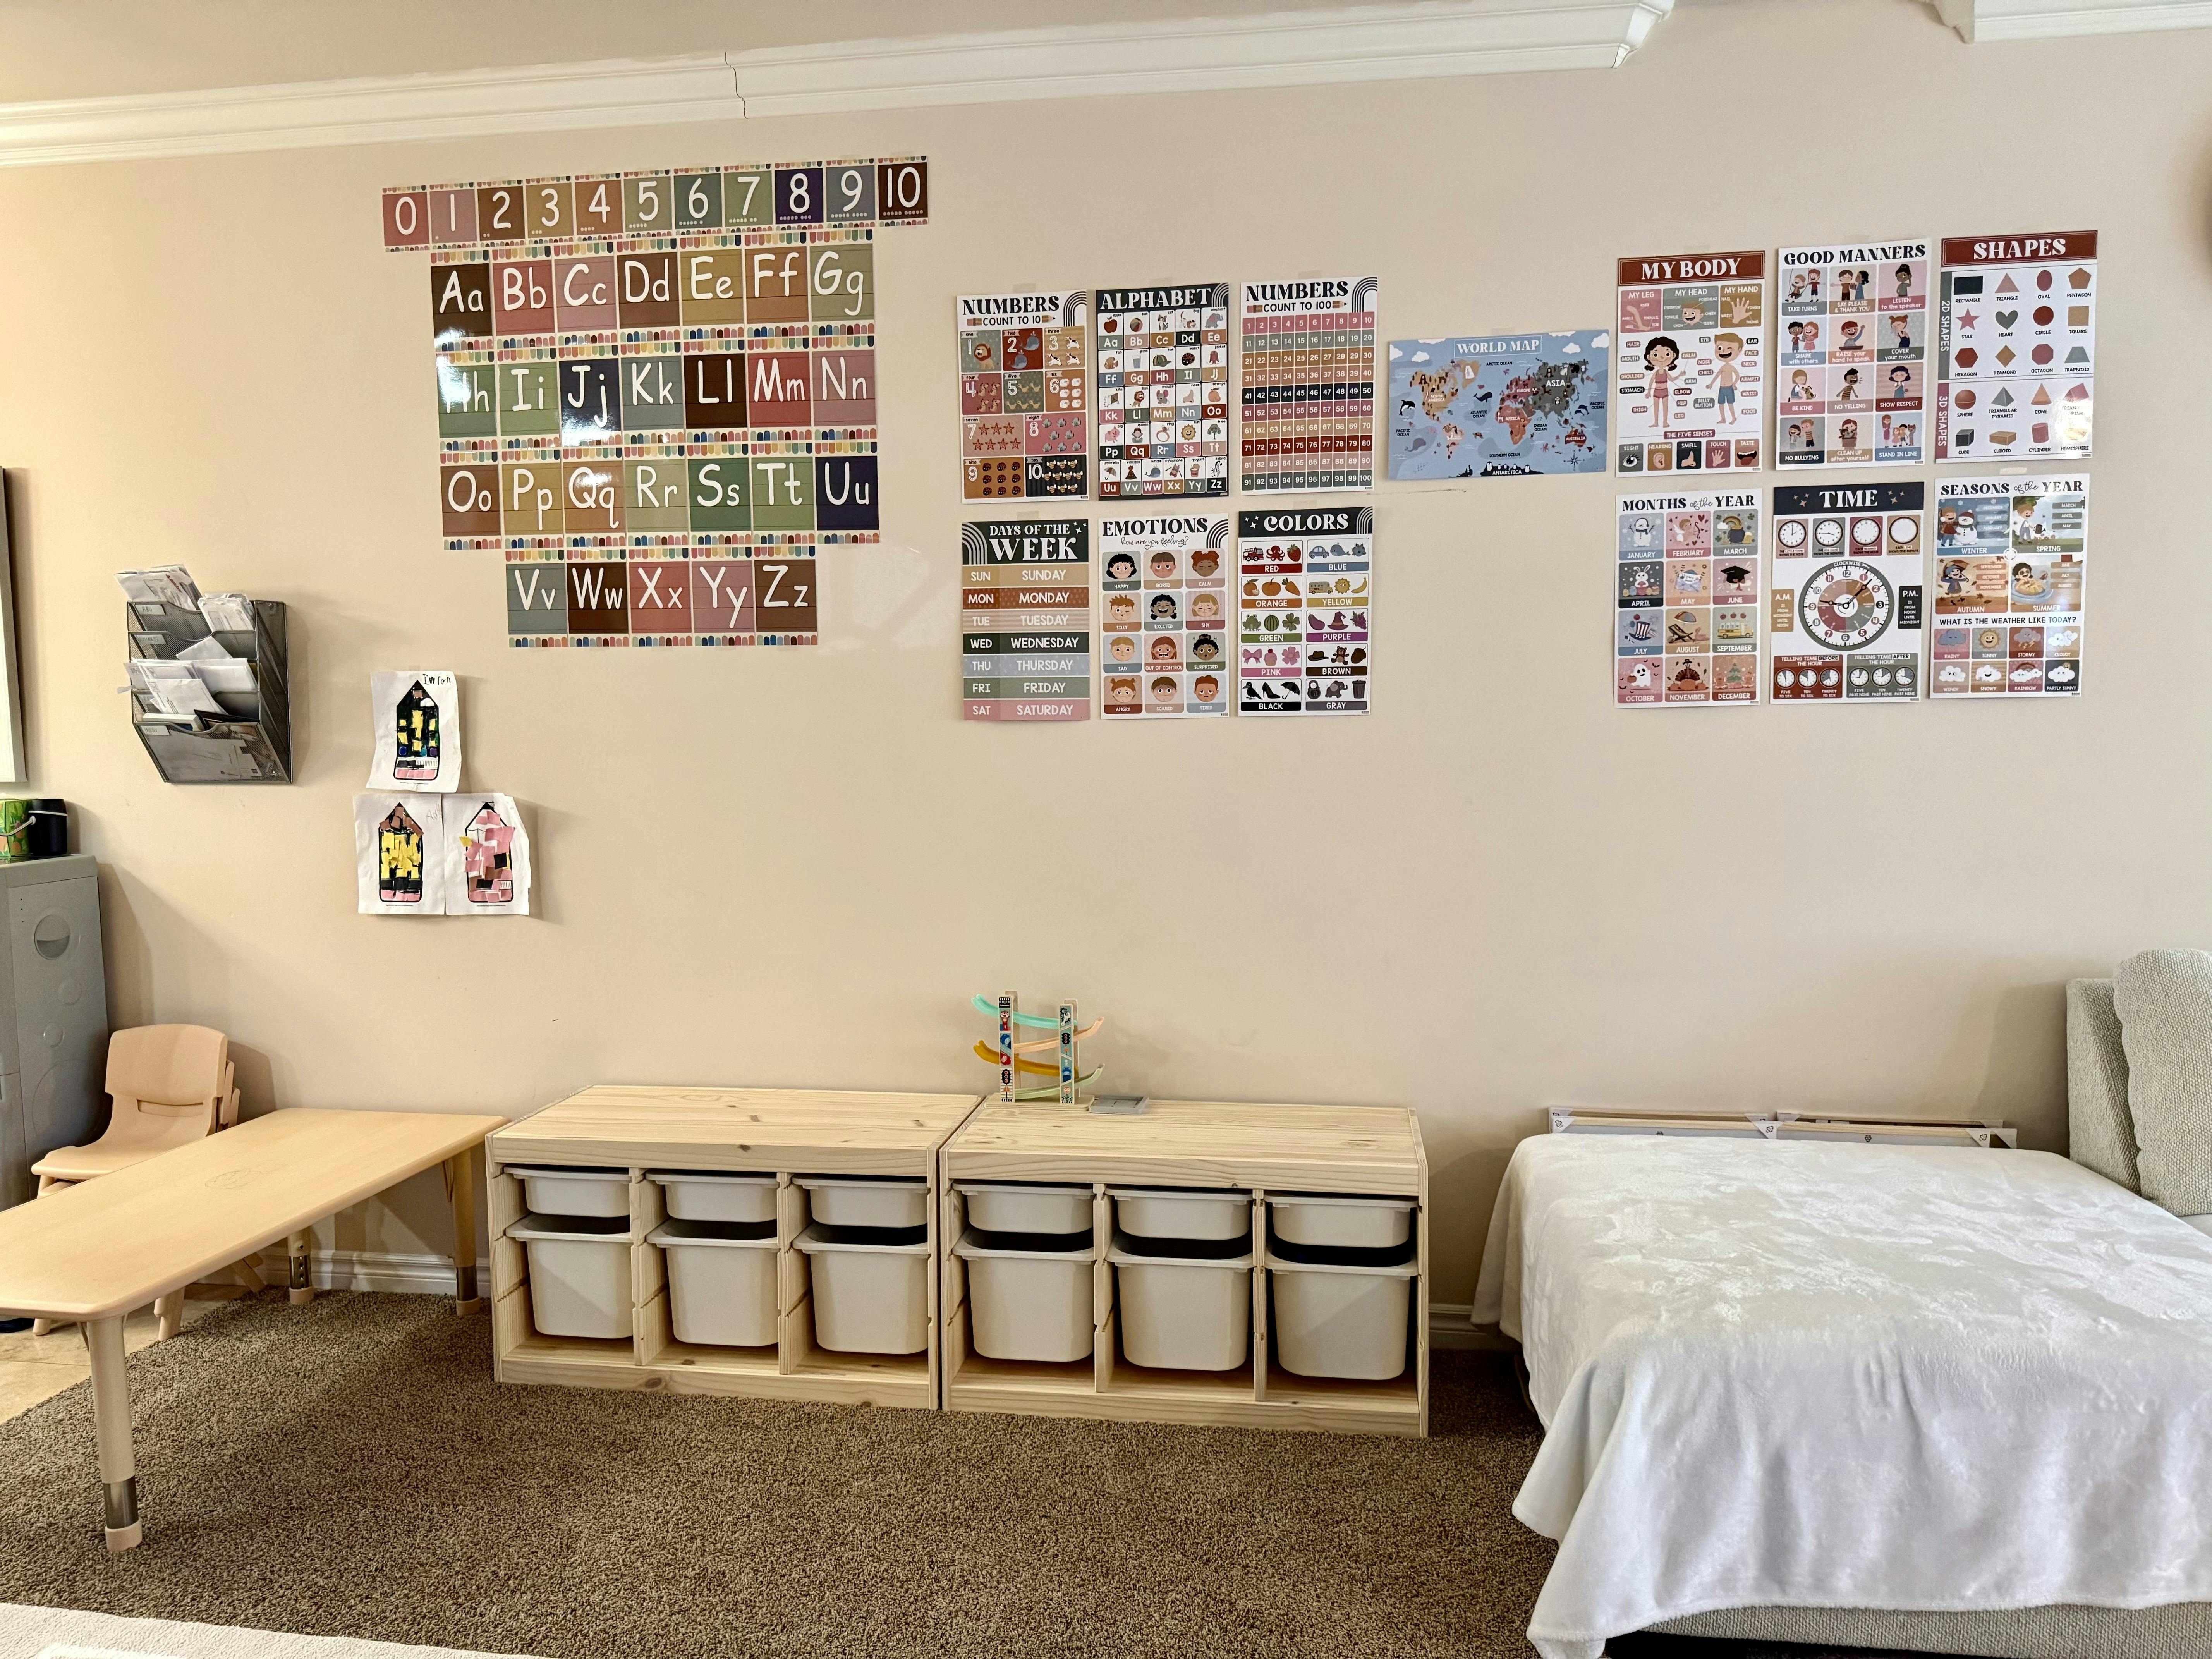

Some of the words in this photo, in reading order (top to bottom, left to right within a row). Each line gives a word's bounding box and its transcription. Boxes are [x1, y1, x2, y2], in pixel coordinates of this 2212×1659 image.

[588, 184, 610, 223] 4
[638, 181, 658, 221] 5
[688, 178, 708, 218] 6
[737, 176, 761, 216] 7
[789, 173, 810, 213] 8
[840, 170, 862, 211] 9
[887, 167, 921, 208] 10
[395, 197, 416, 235] 0
[450, 194, 455, 232] 1
[492, 191, 512, 229] 2
[541, 189, 559, 227] 3
[1784, 251, 1834, 265] GOOD
[1839, 244, 1925, 263] MANNERS
[1974, 238, 2066, 259] SHAPES
[503, 266, 545, 311] Bb
[563, 263, 607, 307] Cc
[625, 258, 670, 303] Dd
[690, 256, 733, 300] Ee
[753, 252, 799, 298] Ff
[814, 251, 863, 316] Gg
[1641, 262, 1676, 280] MY
[1680, 258, 1741, 278] BODY
[439, 270, 484, 314] Aa
[963, 296, 1059, 315] NUMBERS
[1100, 288, 1211, 309] ALPHABET
[1246, 281, 1348, 301] NUMBERS
[1264, 303, 1296, 312] COUNT
[1300, 302, 1312, 310] TO
[1316, 301, 1331, 309] 100
[983, 317, 1013, 325] COUNT
[1456, 341, 1506, 354] WORLD
[1510, 340, 1539, 351] MAP
[511, 368, 544, 412] Ii
[567, 365, 608, 429] Jj
[632, 362, 674, 406] Kk
[754, 358, 805, 402] Mm
[822, 356, 867, 400] Nn
[1939, 396, 1948, 408] 3D
[1938, 410, 1947, 447] SHAPES
[448, 471, 492, 512] Oo
[514, 469, 553, 531] Pp
[569, 467, 619, 529] Qq
[637, 466, 678, 508] Rr
[697, 464, 740, 507] Ss
[756, 462, 804, 506] Tt
[824, 461, 870, 505] Uu
[1819, 490, 1877, 508] TIME
[1941, 483, 2009, 495] SEASONS
[2024, 481, 2039, 490] the
[2042, 481, 2083, 492] YEAR
[1264, 514, 1348, 531] COLORS
[1623, 498, 1686, 512] MONTHS
[1699, 497, 1713, 507] the
[1715, 495, 1755, 507] YEAR
[990, 526, 1021, 536] DAYS
[1024, 525, 1041, 535] OF
[1043, 524, 1070, 534] THE
[1103, 518, 1207, 536] EMOTIONS
[1121, 537, 1134, 545] how
[989, 537, 1078, 561] WEEK
[514, 568, 556, 611] Vv
[572, 567, 623, 610] Ww
[638, 567, 683, 609] Xx
[763, 565, 809, 608] Zz
[971, 572, 991, 581] SUN
[1022, 570, 1066, 580] SUNDAY
[699, 566, 747, 629] Yy
[968, 594, 994, 604] MON
[1019, 592, 1070, 603] MONDAY
[972, 617, 990, 626] TUE
[1020, 615, 1068, 626] TUESDAY
[970, 639, 992, 649] WED
[1011, 637, 1079, 649] WEDNESDAY
[972, 661, 991, 671] THU
[1017, 660, 1073, 671] THURSDAY
[972, 684, 991, 693] FRI
[1024, 682, 1066, 693] FRIDAY
[973, 706, 991, 715] SAT
[1017, 705, 1073, 716] SATURDAY
